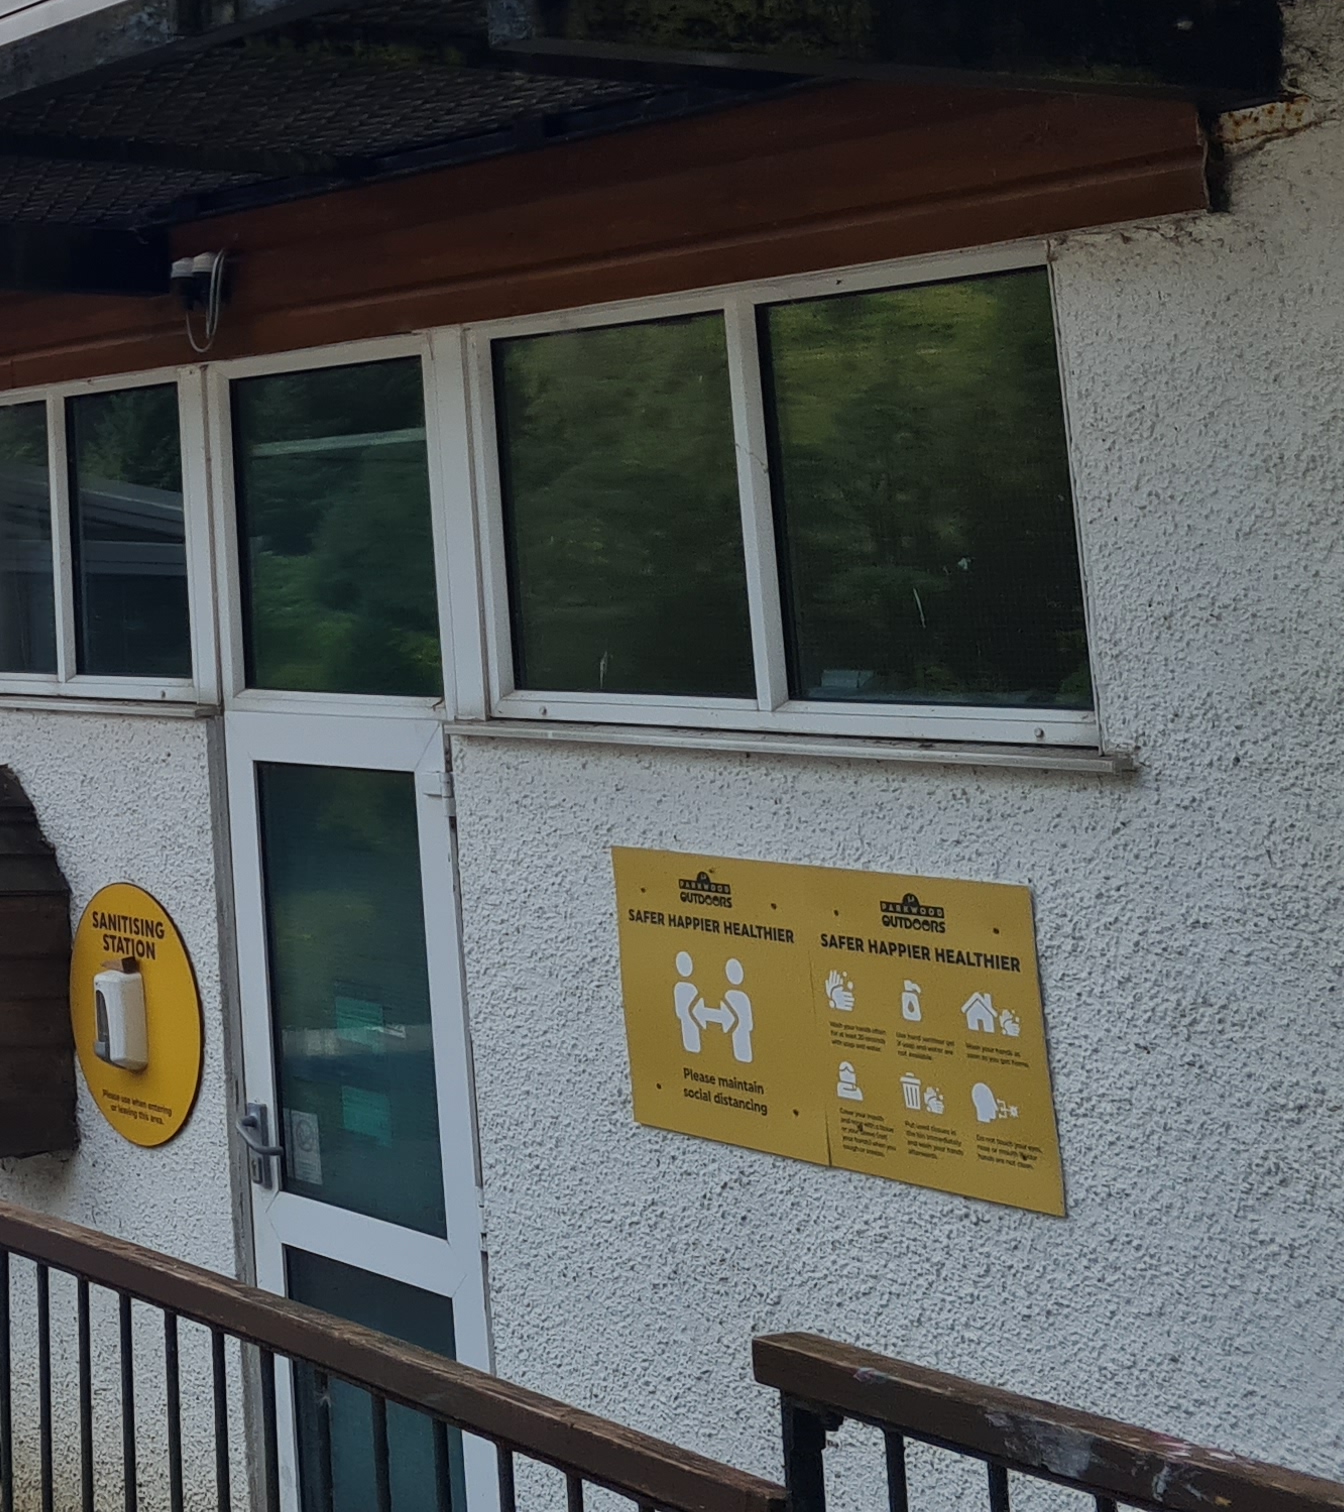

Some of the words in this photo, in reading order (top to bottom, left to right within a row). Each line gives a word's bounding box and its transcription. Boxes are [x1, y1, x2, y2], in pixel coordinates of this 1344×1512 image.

[881, 902, 943, 918] PARKWOOD
[93, 911, 165, 939] SANITISING
[628, 909, 664, 925] SAFER
[668, 914, 720, 934] HAPPIER
[724, 921, 794, 943] HEALTHIER
[882, 915, 946, 934] OUTDOORS
[103, 934, 155, 960] STATION
[820, 933, 864, 952] SAFER
[868, 939, 931, 961] HAPPIER
[934, 948, 1021, 972] HEALTHIER
[684, 1068, 715, 1085] Please
[718, 1077, 764, 1095] maintain
[684, 1088, 711, 1102] social
[714, 1093, 767, 1116] distancing
